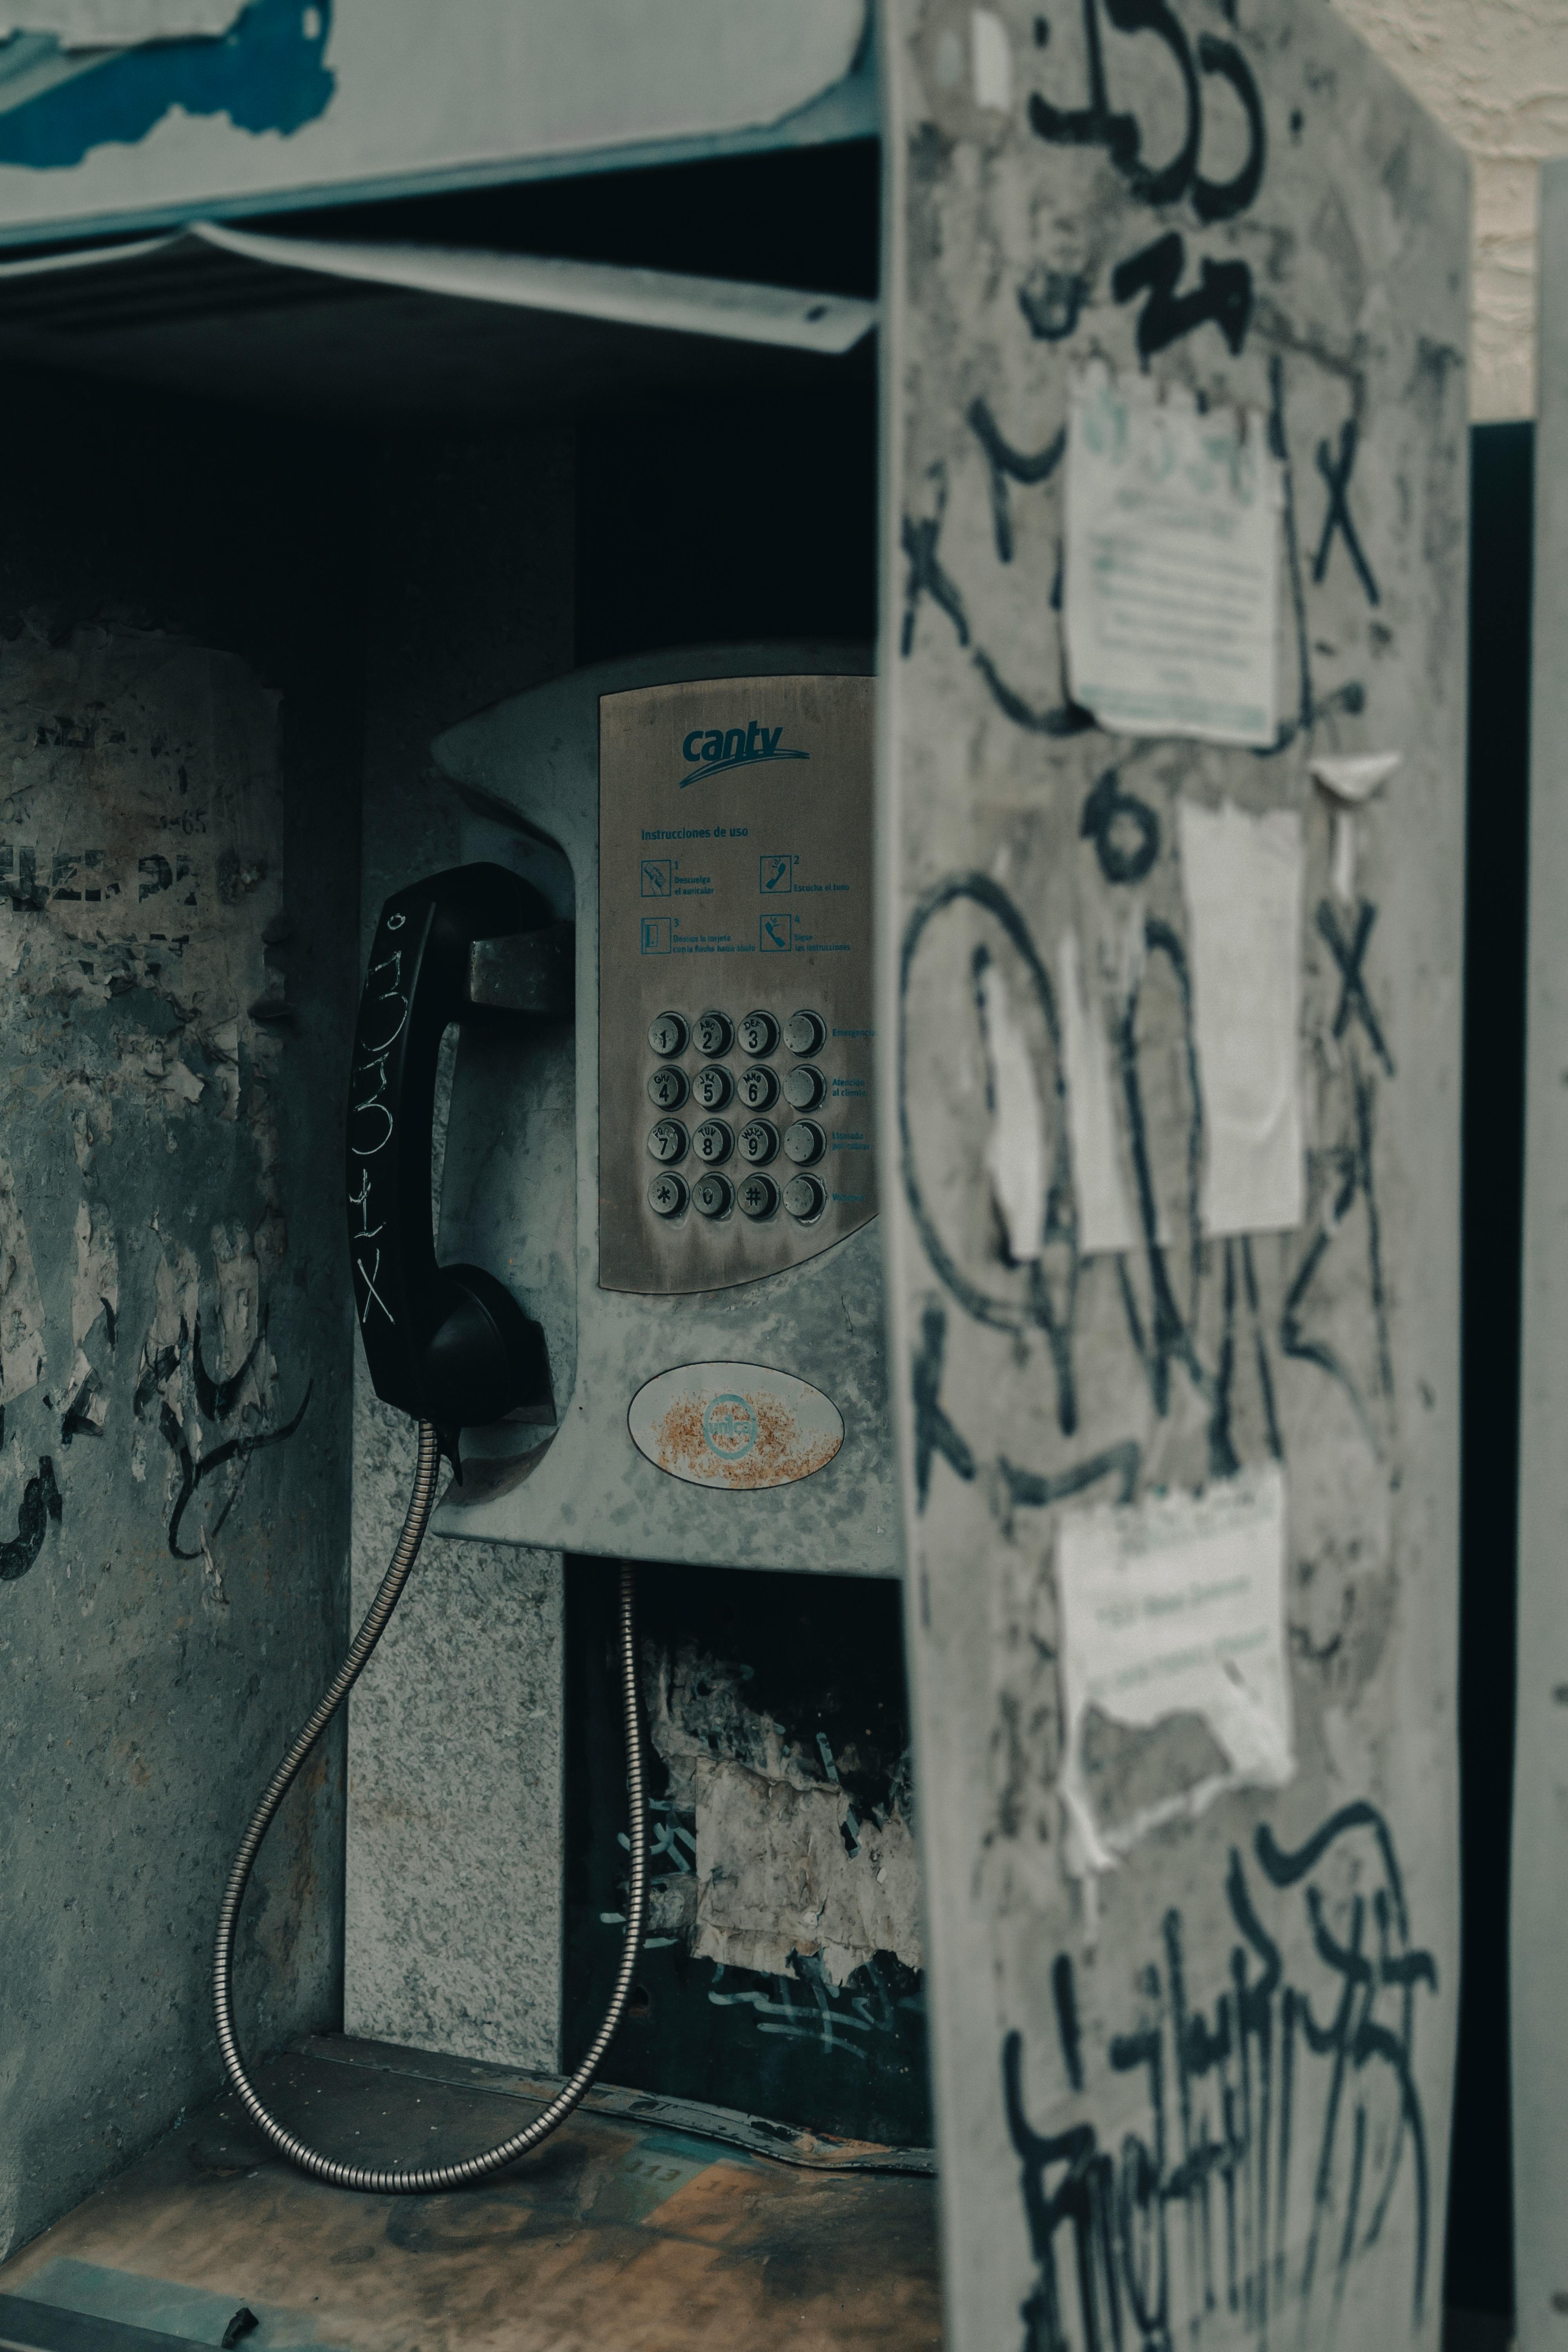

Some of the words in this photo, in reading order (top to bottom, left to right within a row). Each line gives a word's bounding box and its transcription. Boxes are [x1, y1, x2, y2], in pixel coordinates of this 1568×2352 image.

[682, 720, 783, 762] cantv
[641, 828, 711, 840] Instrucciones
[713, 826, 726, 838] de
[730, 828, 749, 837] uso
[674, 860, 679, 869] 1
[794, 855, 800, 864] 2
[674, 875, 711, 885] Descuelga
[682, 887, 714, 895] auricular
[794, 884, 823, 892] Escucha
[673, 918, 679, 927] 3
[700, 1021, 715, 1031] ABC
[660, 1030, 666, 1049] 1
[702, 1031, 712, 1049] 2
[748, 1030, 758, 1049] 3
[654, 1073, 670, 1084] GHI
[700, 1073, 715, 1085] JKL
[742, 1073, 761, 1084] MNO
[659, 1084, 669, 1102] 4
[704, 1084, 713, 1102] 5
[748, 1083, 758, 1102] 6
[698, 1127, 716, 1137] TUV
[741, 1127, 763, 1140] WXYZ
[659, 1138, 668, 1155] 7
[702, 1138, 713, 1156] 8
[748, 1138, 758, 1156] 9
[703, 1188, 713, 1205] 0
